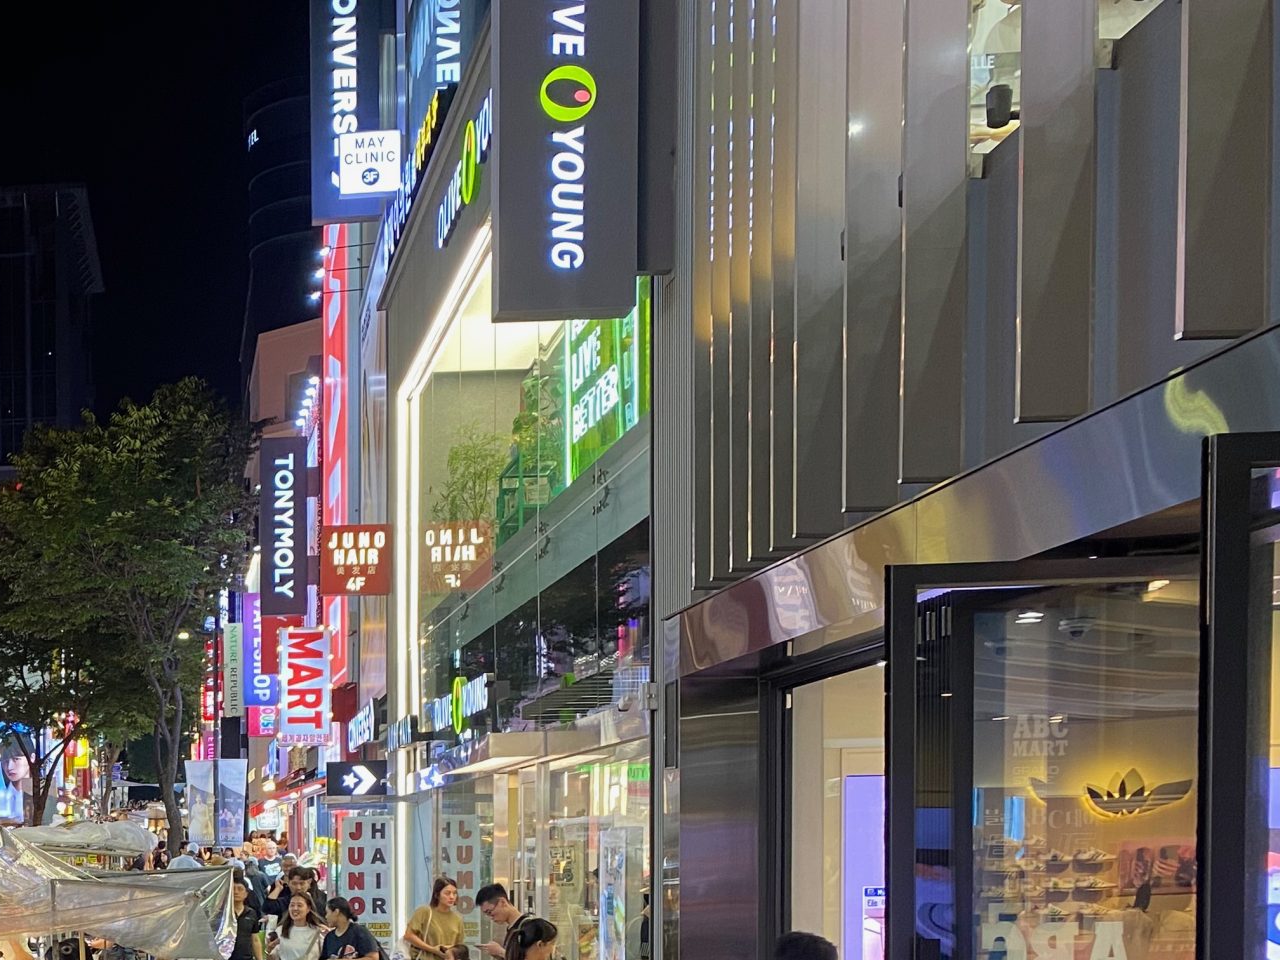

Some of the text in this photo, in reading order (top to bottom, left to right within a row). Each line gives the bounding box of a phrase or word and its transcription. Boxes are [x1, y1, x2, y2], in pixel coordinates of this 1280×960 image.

[344, 150, 396, 164] CLINIC
[355, 136, 385, 149] MAY
[363, 170, 379, 183] 3F
[437, 160, 463, 249] OLIVE
[551, 126, 585, 269] YOUNG
[572, 326, 601, 392] LIVE
[572, 364, 620, 444] BETTER
[272, 453, 295, 599] TONYMOLY
[328, 531, 386, 549] JUNO
[333, 548, 379, 566] HAIR
[346, 576, 366, 591] 4F
[229, 626, 239, 714] NATURE REPUBLIC
[287, 632, 324, 730] MART
[1012, 739, 1068, 757] MART
[1013, 713, 1068, 738] ABC
[348, 821, 365, 916] JUNO
[371, 822, 387, 914] HAIR
